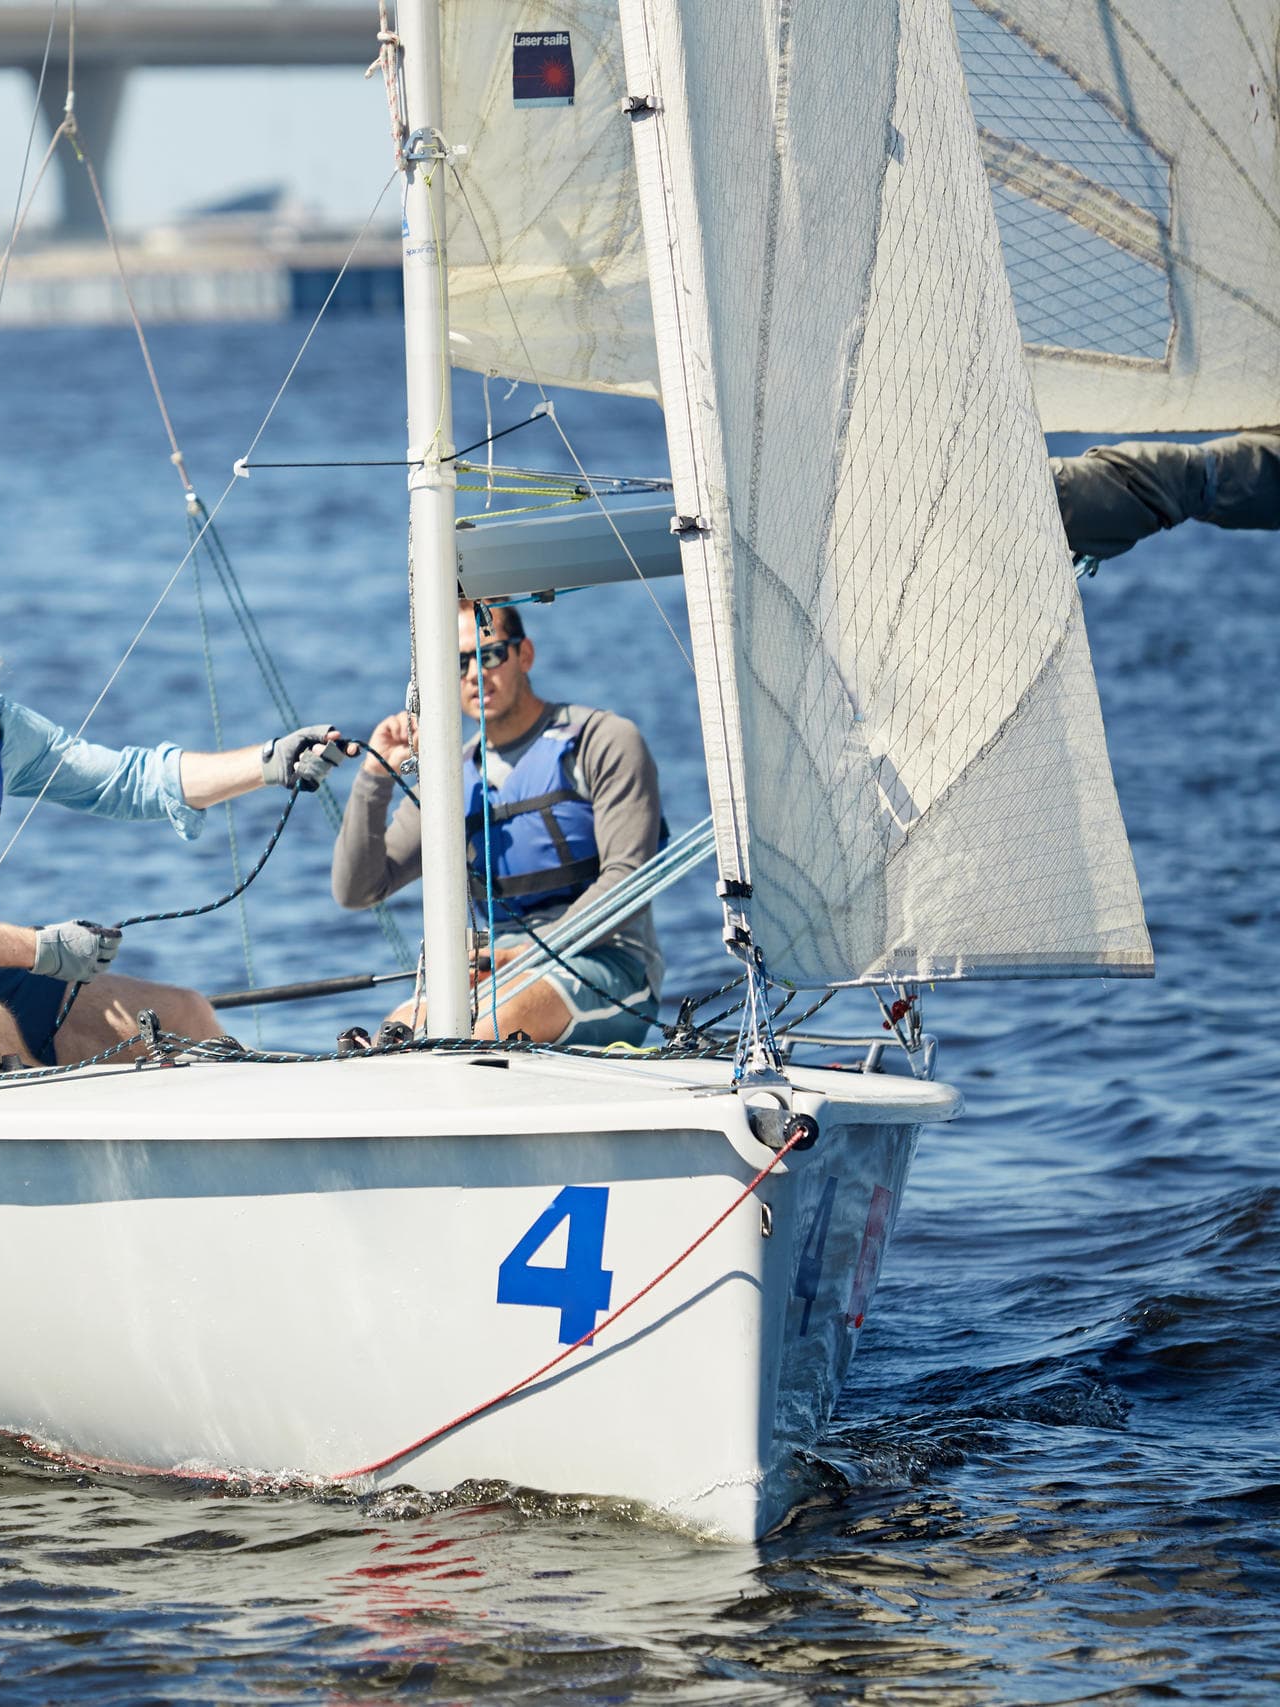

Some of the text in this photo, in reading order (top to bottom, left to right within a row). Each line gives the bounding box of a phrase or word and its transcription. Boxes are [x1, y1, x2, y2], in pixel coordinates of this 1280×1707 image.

[514, 33, 569, 46] Laser sails
[497, 1185, 613, 1346] 4
[795, 1176, 839, 1338] 4
